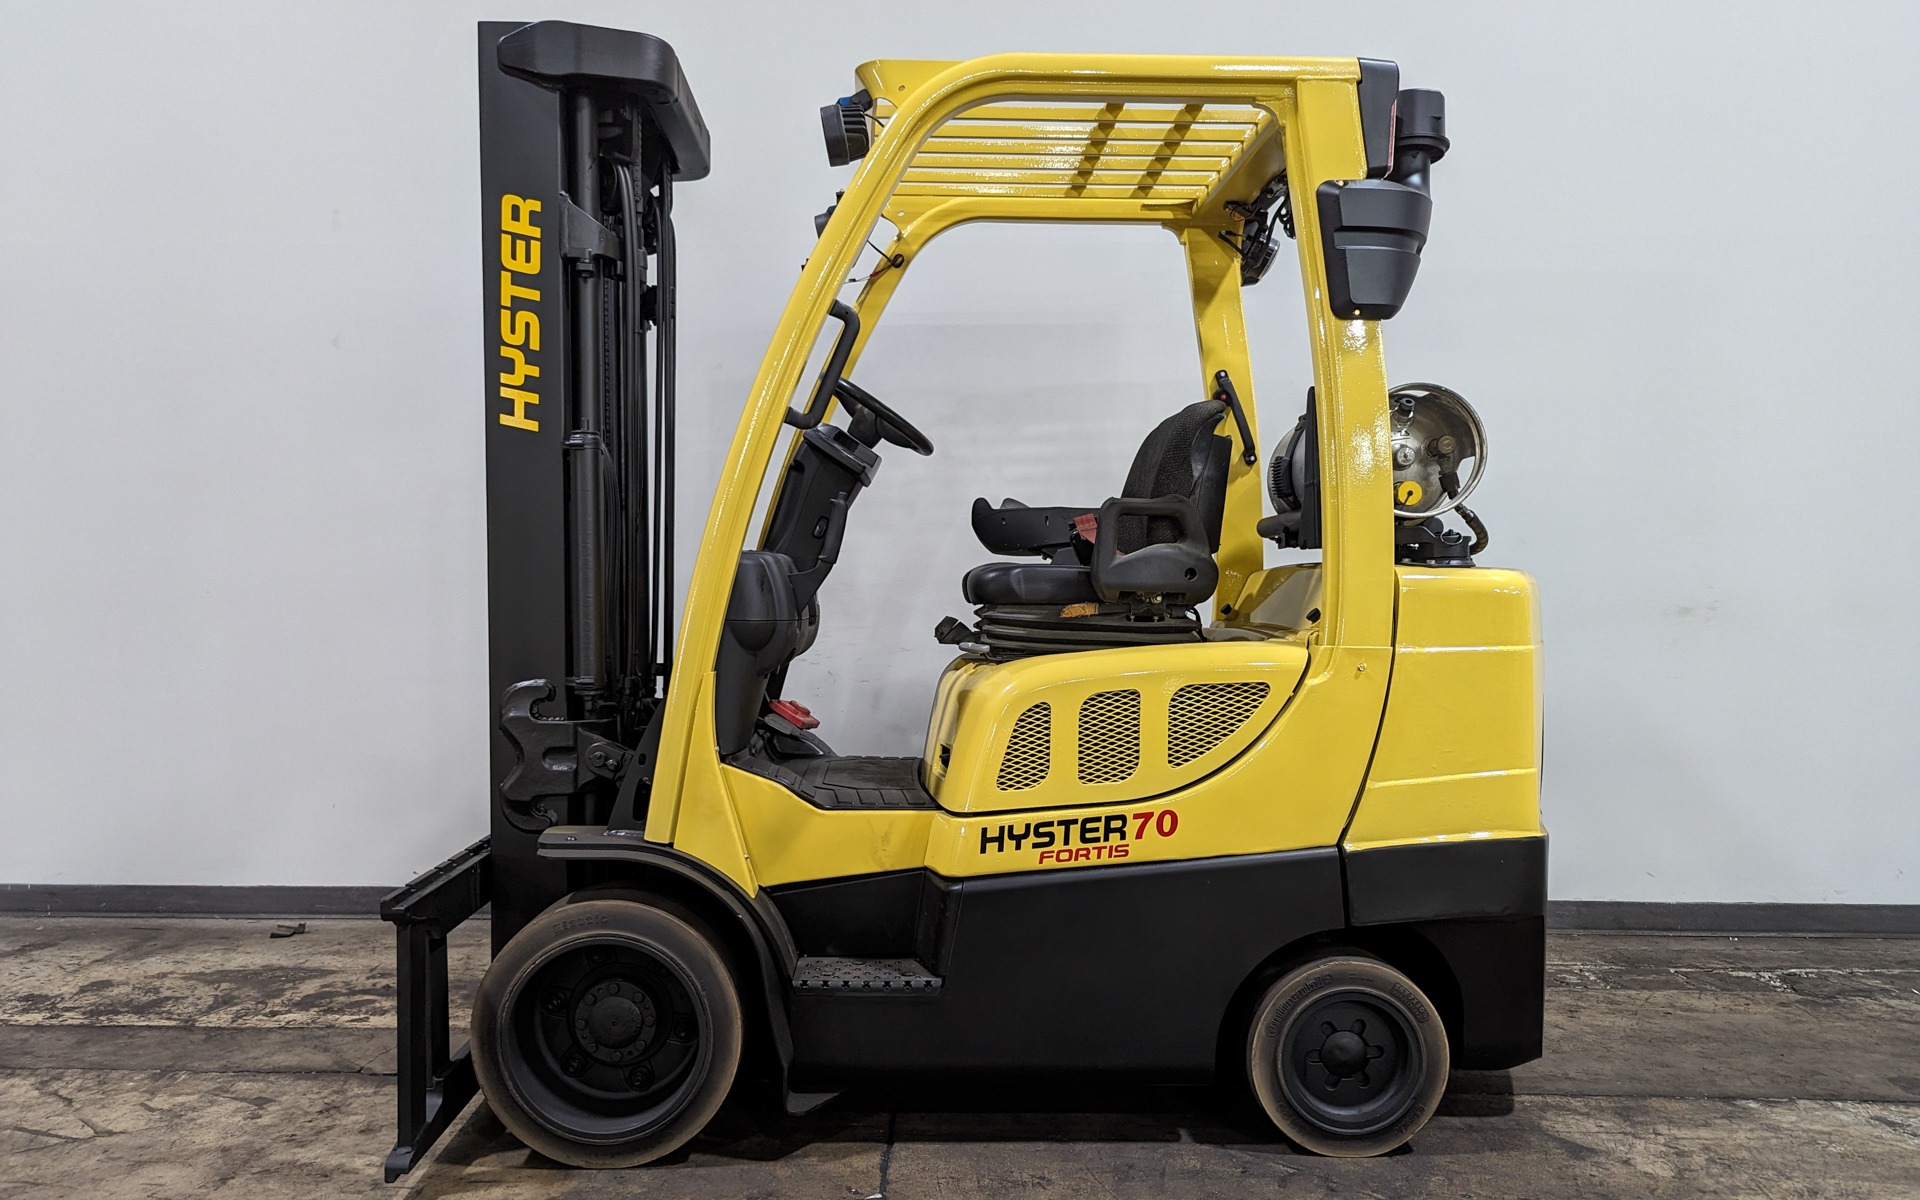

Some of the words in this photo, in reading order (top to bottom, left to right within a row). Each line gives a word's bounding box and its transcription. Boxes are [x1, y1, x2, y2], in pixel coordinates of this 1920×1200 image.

[499, 194, 543, 433] HYSTER
[979, 813, 1128, 855] HYSTER
[1132, 809, 1179, 841] 70
[1038, 843, 1130, 865] FORTIS
